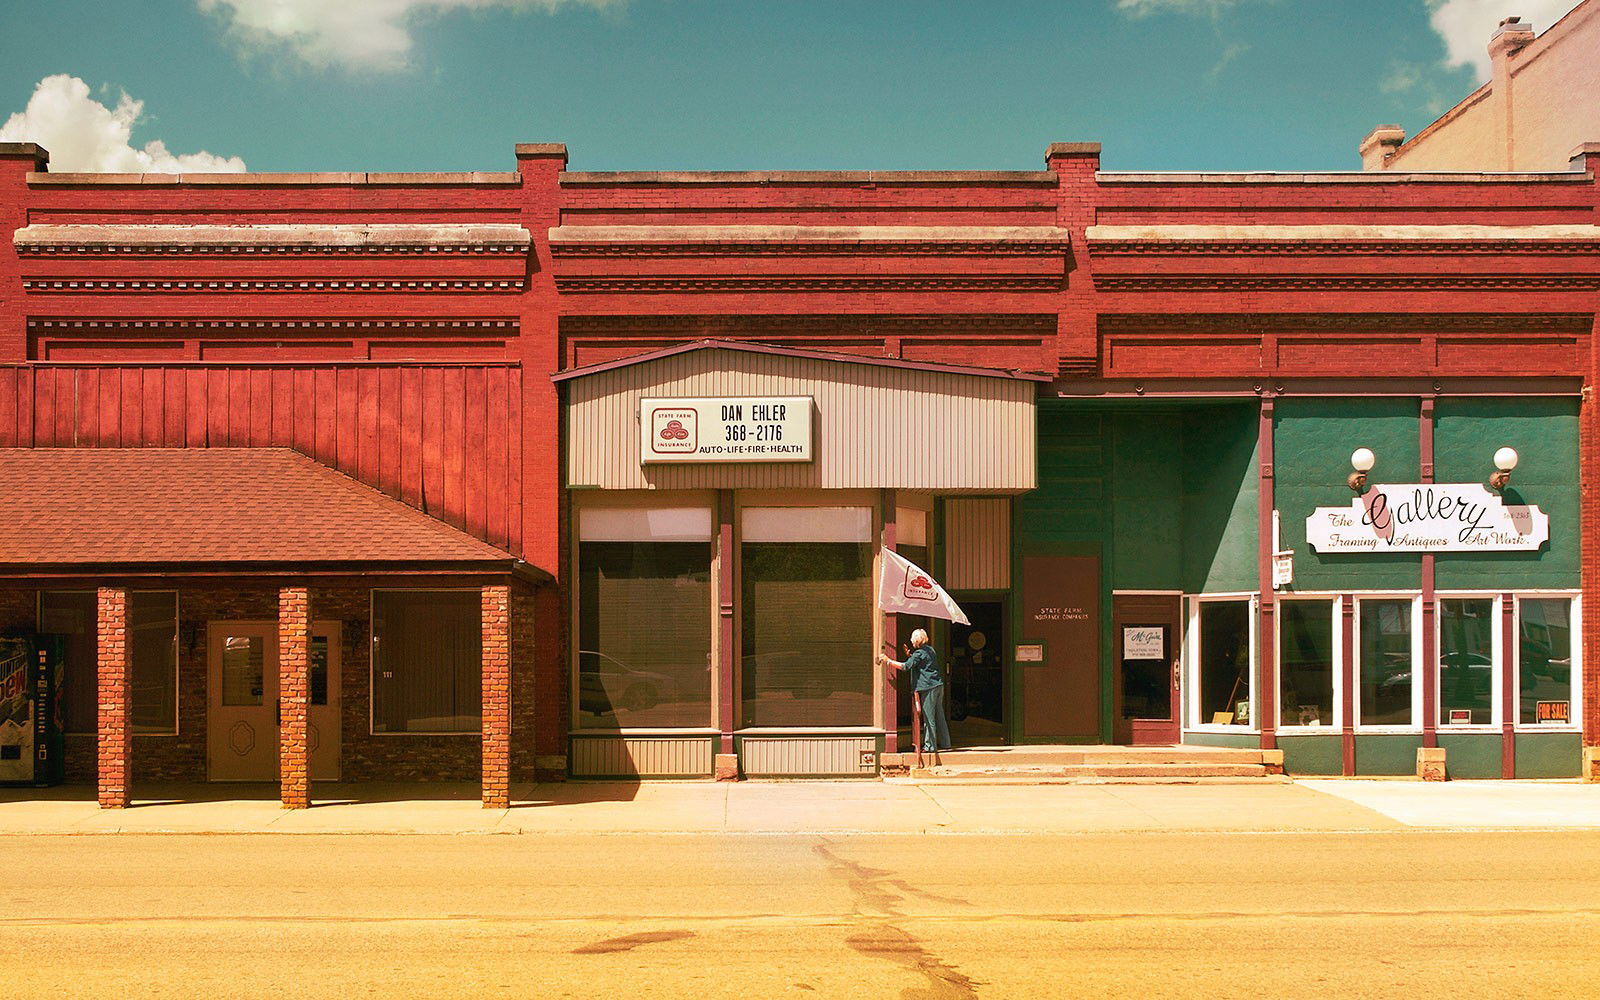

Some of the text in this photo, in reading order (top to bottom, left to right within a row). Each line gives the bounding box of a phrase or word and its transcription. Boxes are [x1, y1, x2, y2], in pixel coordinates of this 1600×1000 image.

[721, 404, 786, 421] DAN EHLER
[725, 424, 782, 441] 368-2176
[1328, 488, 1494, 546] The Gallery
[1329, 533, 1378, 550] Framing
[1392, 533, 1449, 549] Antiques
[1464, 532, 1490, 545] Art
[1538, 703, 1568, 719] FOR SALE
